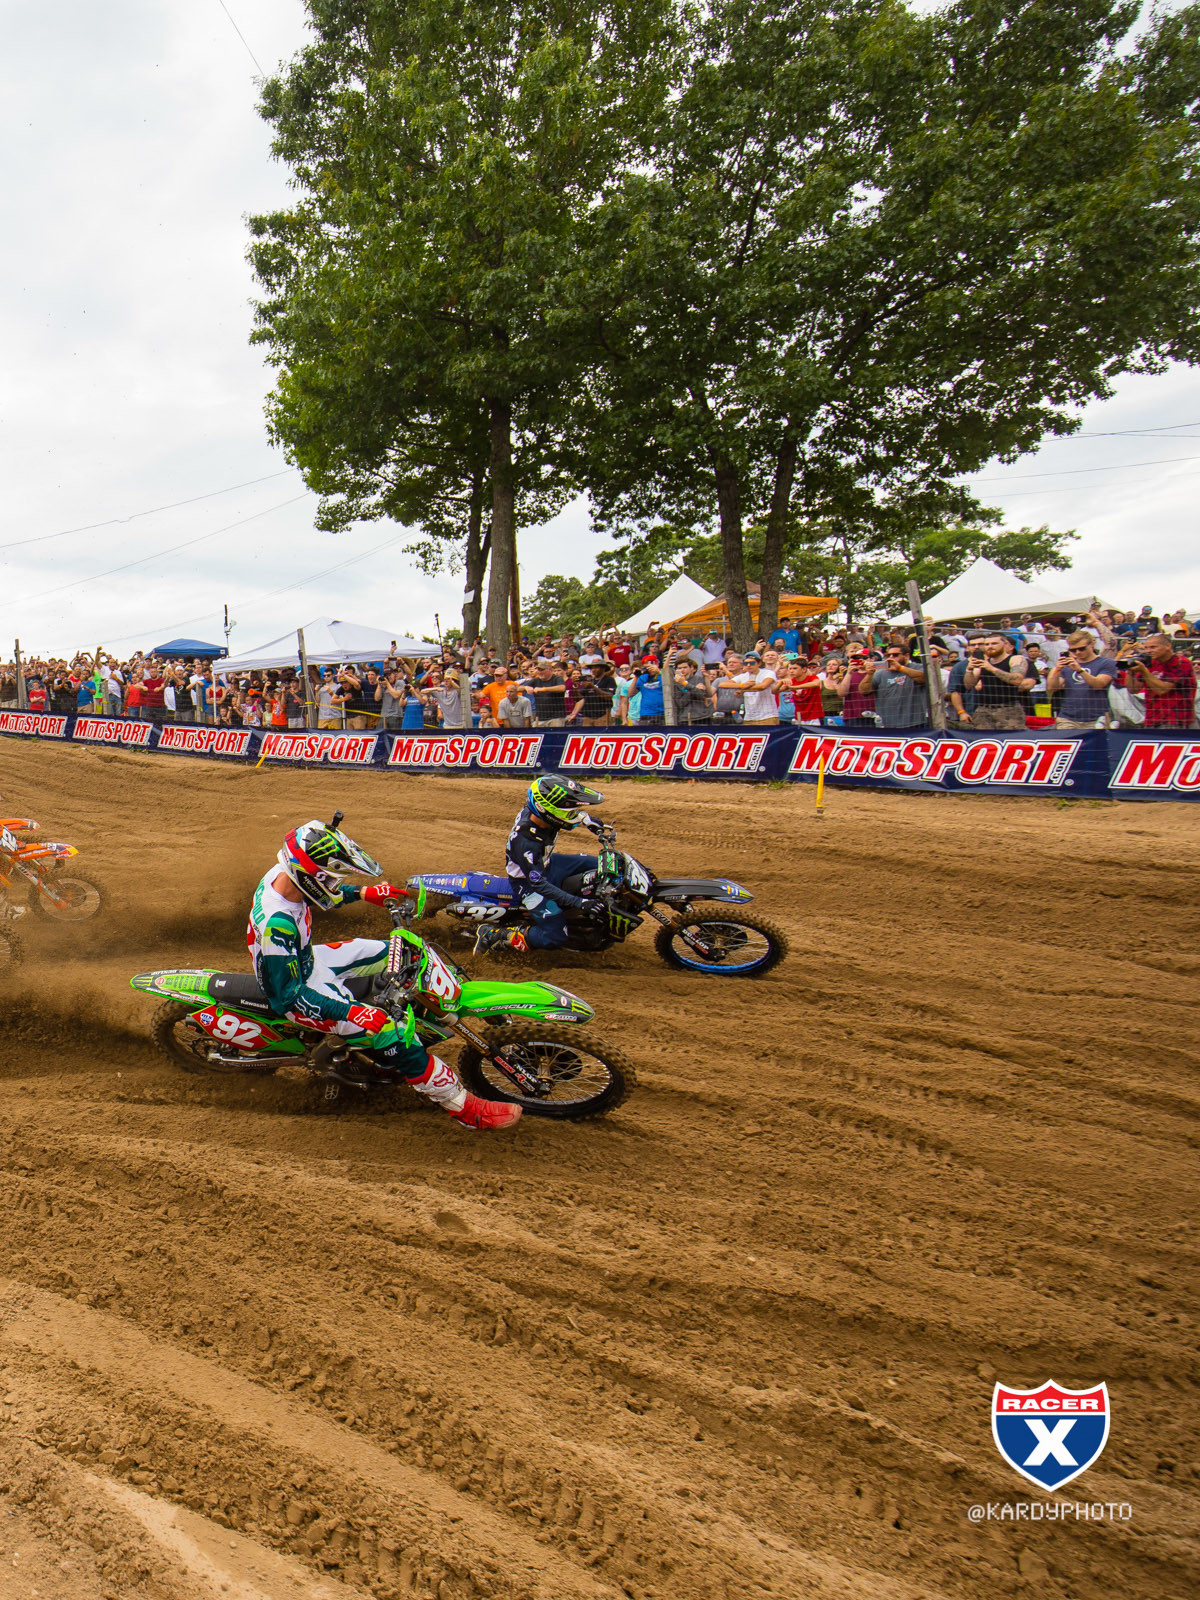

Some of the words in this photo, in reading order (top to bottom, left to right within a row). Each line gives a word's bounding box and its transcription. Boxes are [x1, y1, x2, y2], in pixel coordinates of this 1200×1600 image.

[464, 905, 507, 922] 32
[240, 999, 269, 1010] Kawasaki
[489, 1003, 537, 1012] CIRCUIT
[212, 1014, 262, 1049] 92
[456, 1023, 468, 1035] PRO
[467, 1032, 490, 1050] CIRCUIT
